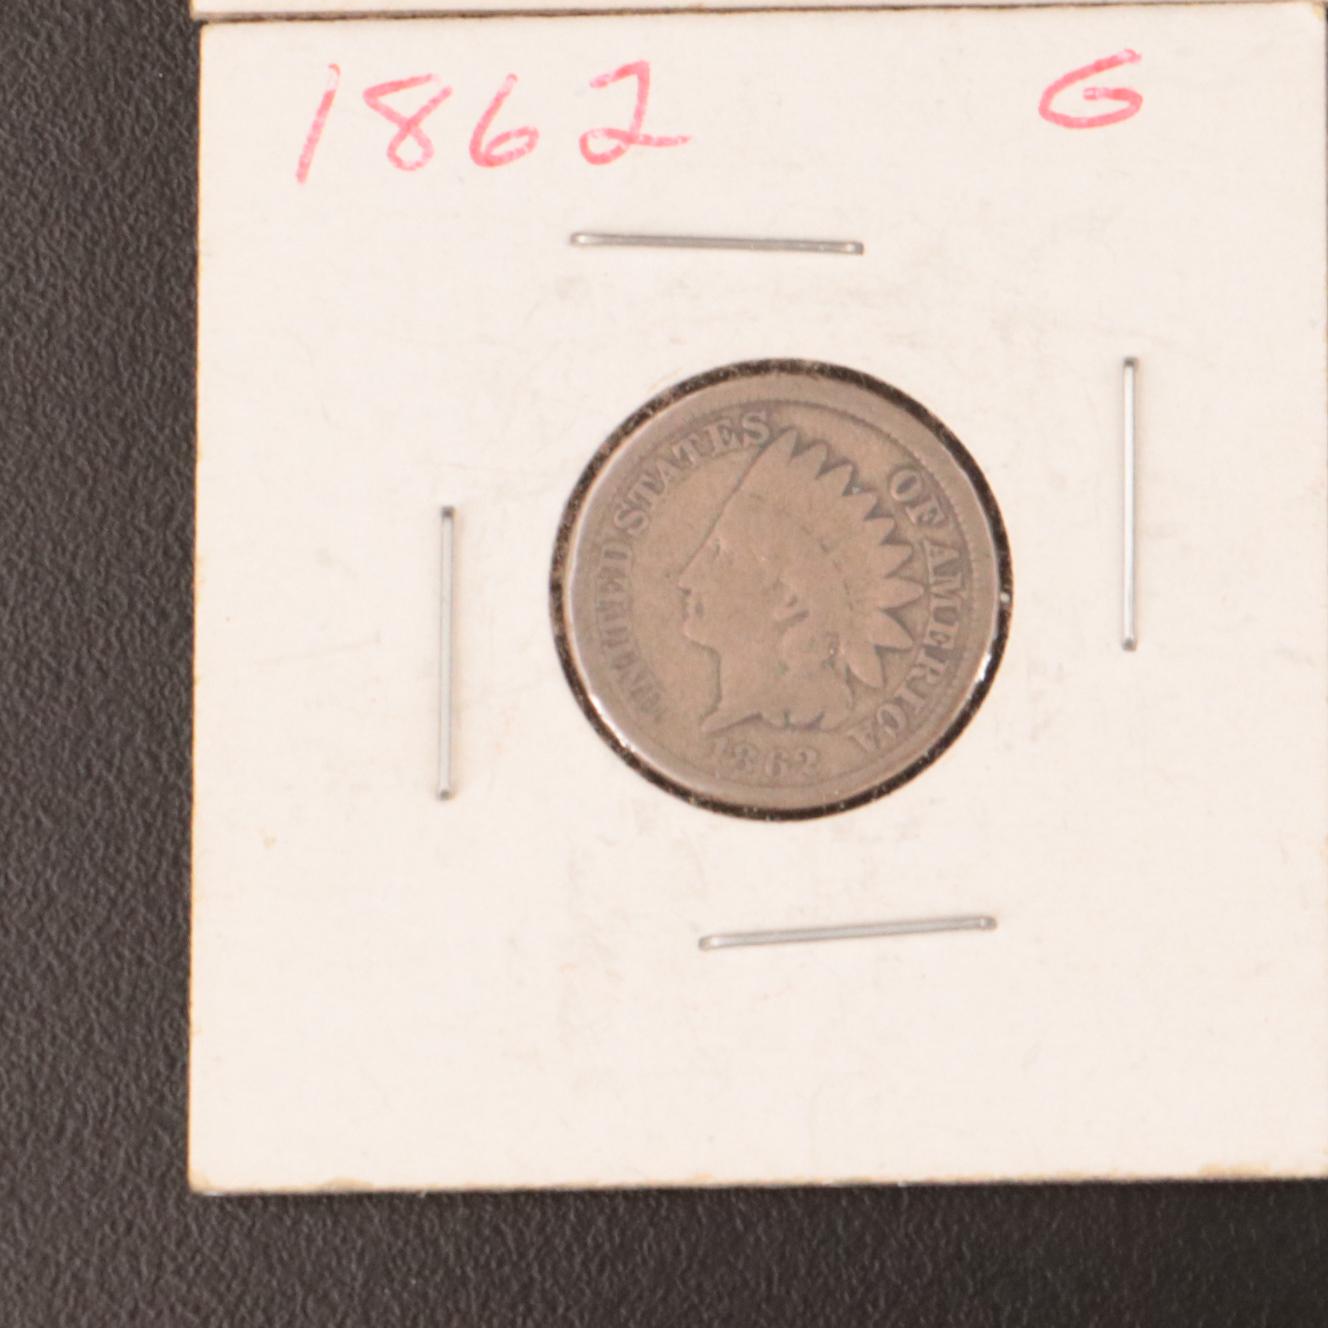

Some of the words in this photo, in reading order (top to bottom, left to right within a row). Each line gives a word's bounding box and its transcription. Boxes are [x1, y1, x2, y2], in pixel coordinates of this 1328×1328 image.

[296, 59, 691, 185] 1862
[1037, 48, 1145, 131] G
[613, 409, 773, 537] STATES
[886, 463, 948, 532] OF
[846, 536, 970, 755] AMERICA
